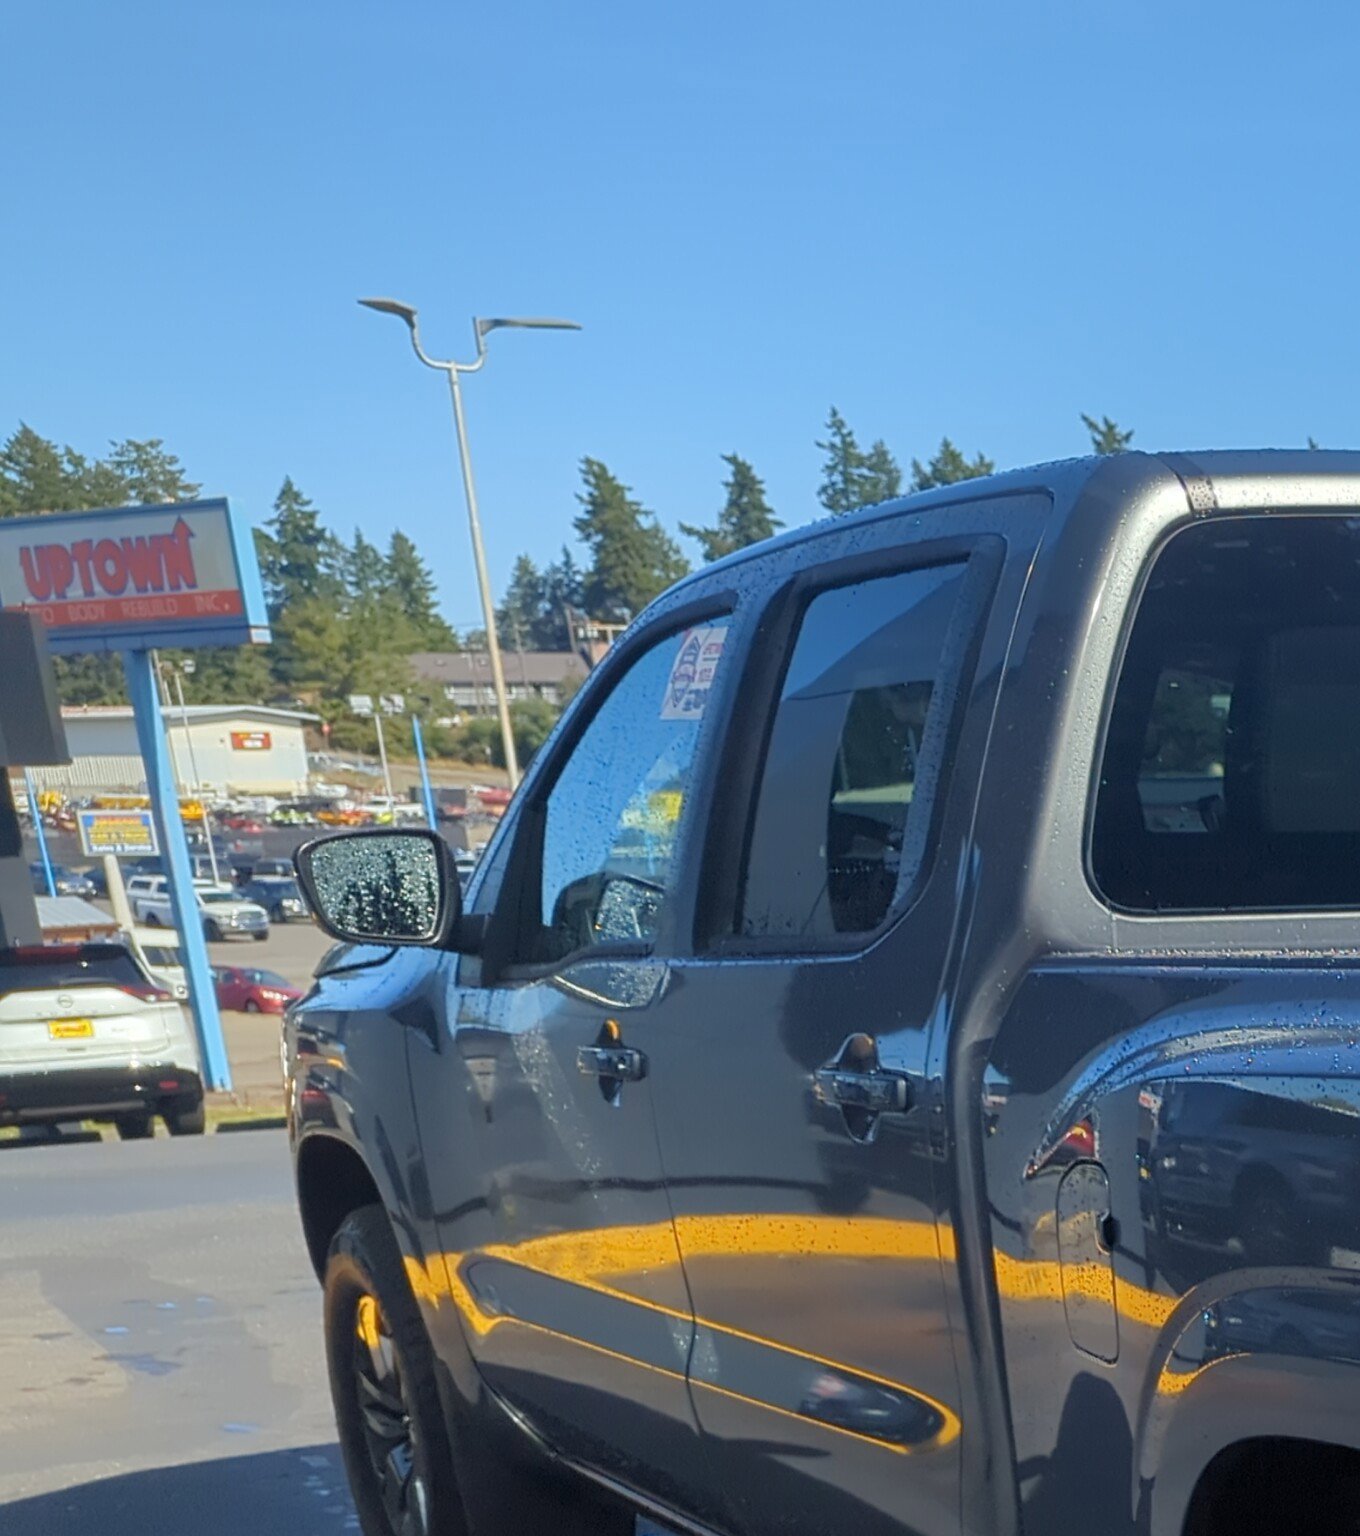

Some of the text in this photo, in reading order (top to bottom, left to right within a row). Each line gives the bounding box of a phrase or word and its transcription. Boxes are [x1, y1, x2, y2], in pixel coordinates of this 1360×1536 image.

[19, 514, 199, 602] UPTOWN
[67, 603, 106, 623] BODY
[120, 598, 178, 619] REBUILD
[194, 593, 231, 613] INC.
